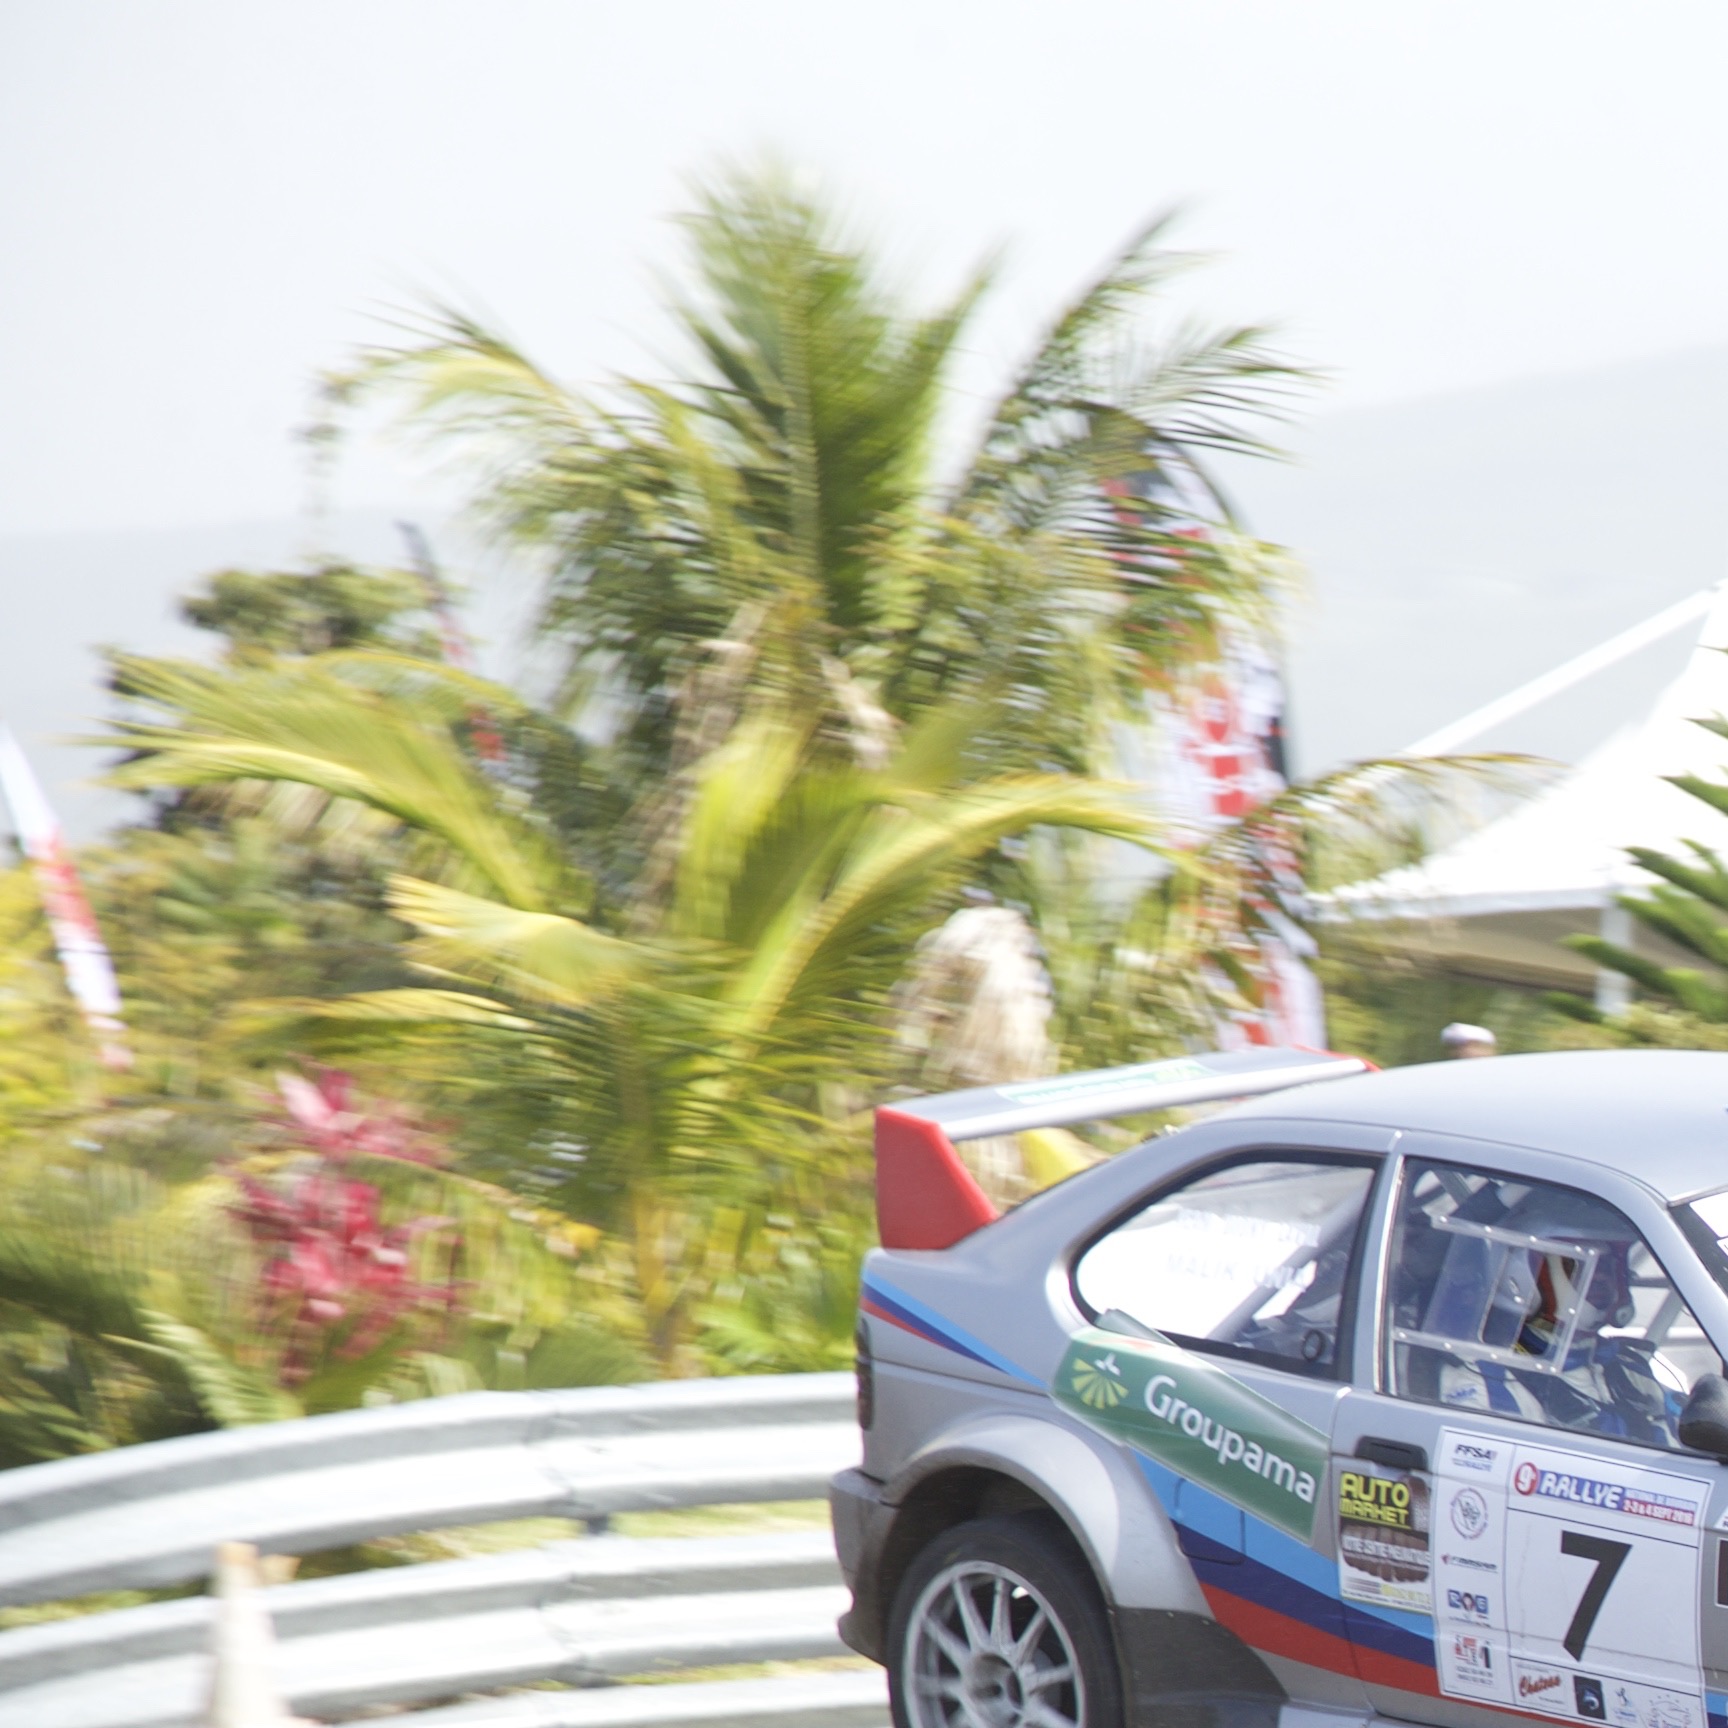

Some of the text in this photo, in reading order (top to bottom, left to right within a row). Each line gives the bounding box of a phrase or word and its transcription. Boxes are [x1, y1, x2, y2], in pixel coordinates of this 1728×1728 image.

[1143, 1374, 1317, 1505] Groupama
[1340, 1472, 1410, 1508] AUTO
[1540, 1477, 1624, 1509] RALLYE
[1339, 1497, 1410, 1525] MARKET
[1560, 1530, 1633, 1662] 7
